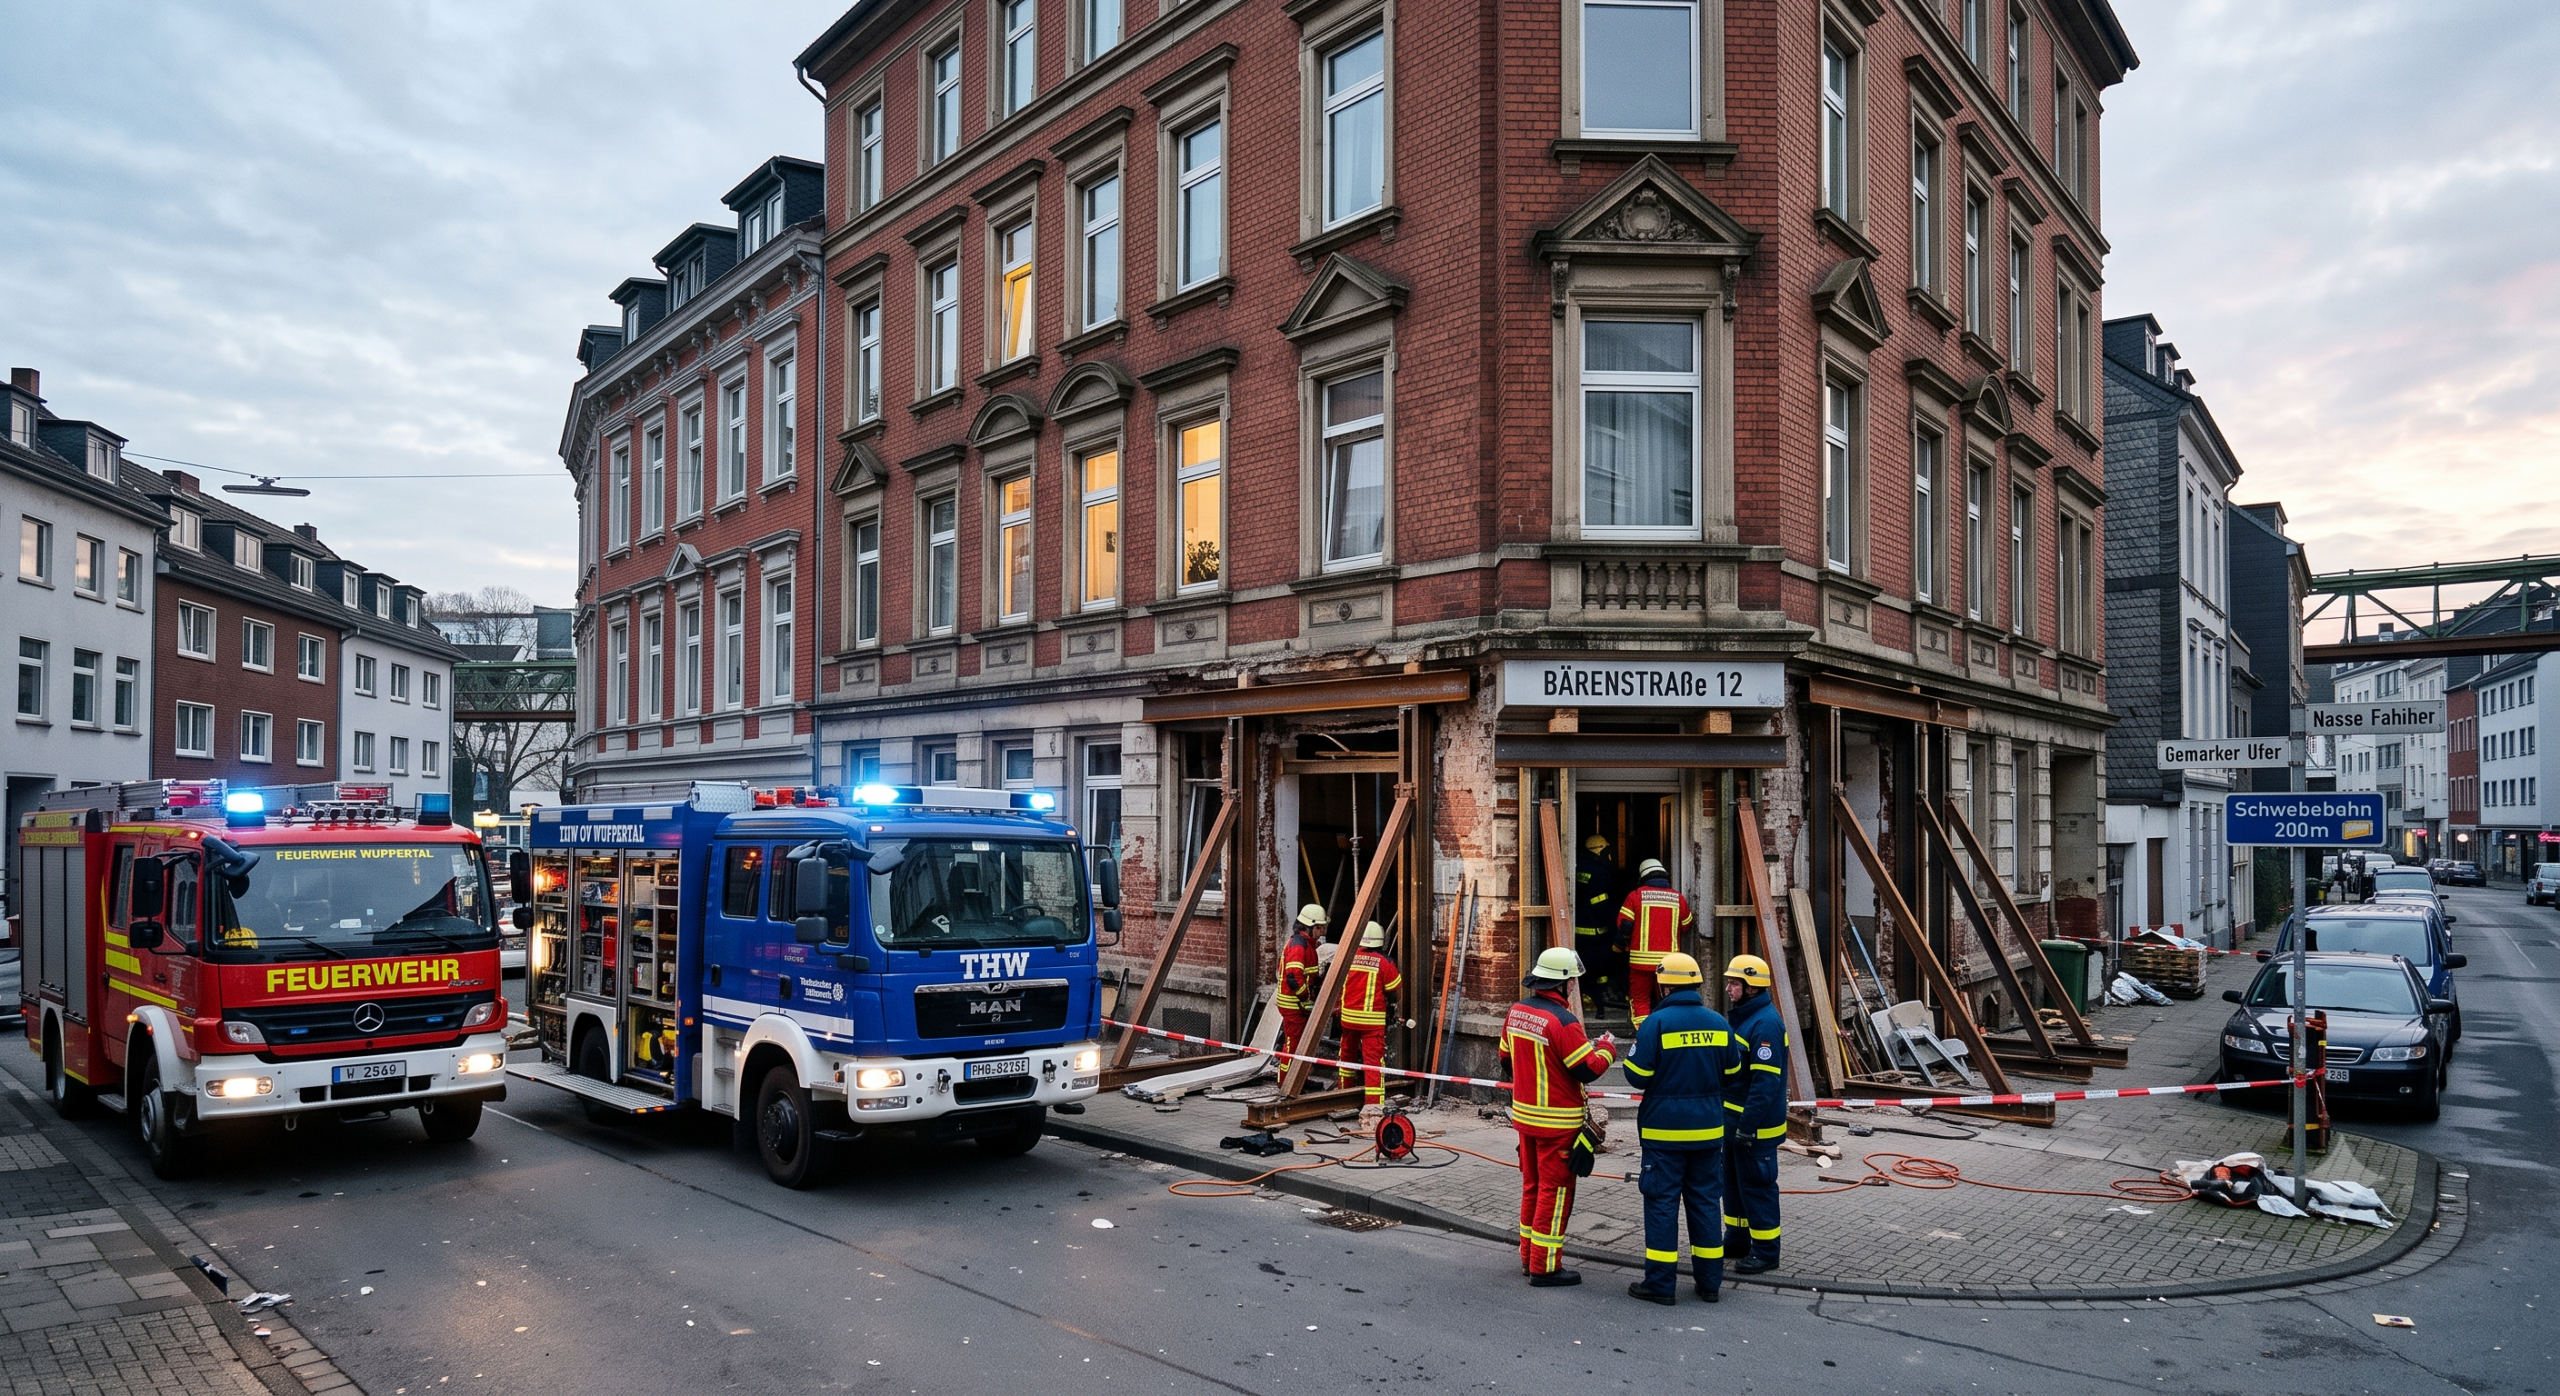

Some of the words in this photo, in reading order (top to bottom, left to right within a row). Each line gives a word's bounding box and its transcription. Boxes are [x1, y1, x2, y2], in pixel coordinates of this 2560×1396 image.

[1543, 665, 1707, 697] BÄRENSTRAße
[1716, 671, 1743, 697] 12
[2313, 710, 2363, 728] Nasse
[2165, 744, 2241, 763] Gemarker
[2247, 743, 2282, 760] Ufer
[2234, 801, 2372, 817] Schwebebahn
[579, 825, 592, 843] OV
[2274, 822, 2329, 838] 200m
[276, 850, 357, 860] FEUERWEHR
[360, 849, 434, 859] WUPPERTAL
[959, 952, 1030, 980] THW
[267, 958, 460, 993] FEUERWEHR
[970, 1000, 1021, 1014] MAN
[1680, 1032, 1714, 1045] THW
[346, 1067, 355, 1080] W
[363, 1064, 397, 1079] 2569
